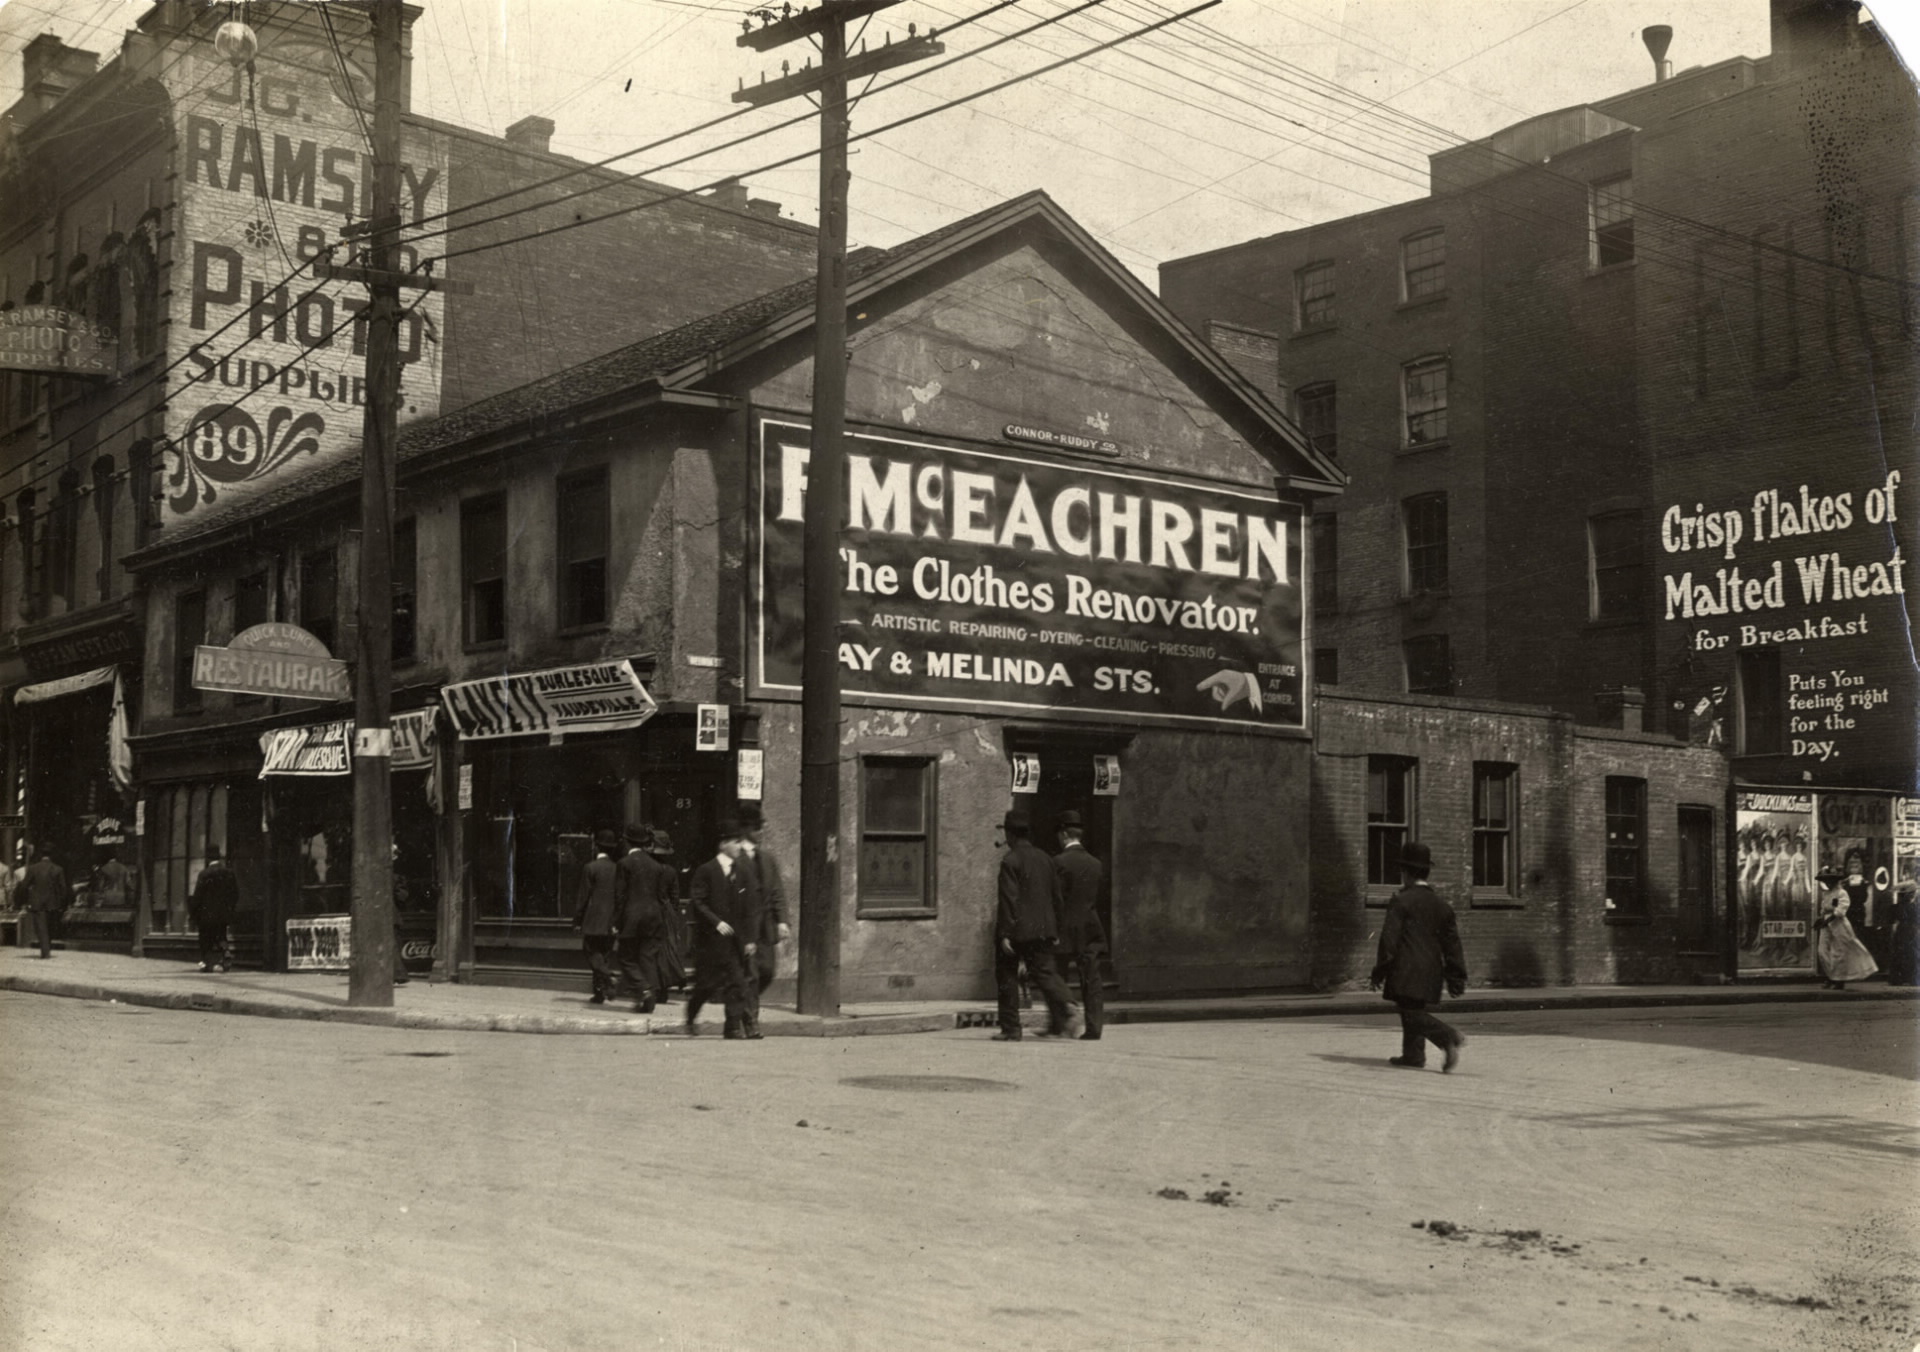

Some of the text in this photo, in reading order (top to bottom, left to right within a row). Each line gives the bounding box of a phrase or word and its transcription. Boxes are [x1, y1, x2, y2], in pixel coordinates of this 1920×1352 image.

[10, 308, 77, 327] RAMSEY
[8, 326, 80, 352] PHOTO
[0, 352, 111, 370] UPPLIES.
[185, 343, 416, 413] SUPPLIE.
[194, 420, 257, 465] 89
[1662, 470, 1900, 559] Crisp flakes of
[839, 548, 1259, 635] he Clothes Renovator.
[1664, 546, 1906, 620] Malted Wheat
[872, 613, 941, 633] ARTISTIC
[1695, 613, 1868, 650] for Breakfast
[243, 626, 318, 649] QUICK LUNCH
[838, 643, 1160, 694] AY & MELINDA STS.
[1258, 662, 1296, 677] ENTRANCE
[1268, 679, 1281, 690] AT
[1789, 670, 1864, 691] Puts You
[1788, 688, 1888, 711] feeling right
[1790, 714, 1855, 733] for the
[1792, 739, 1840, 761] Day.
[676, 798, 692, 809] 83
